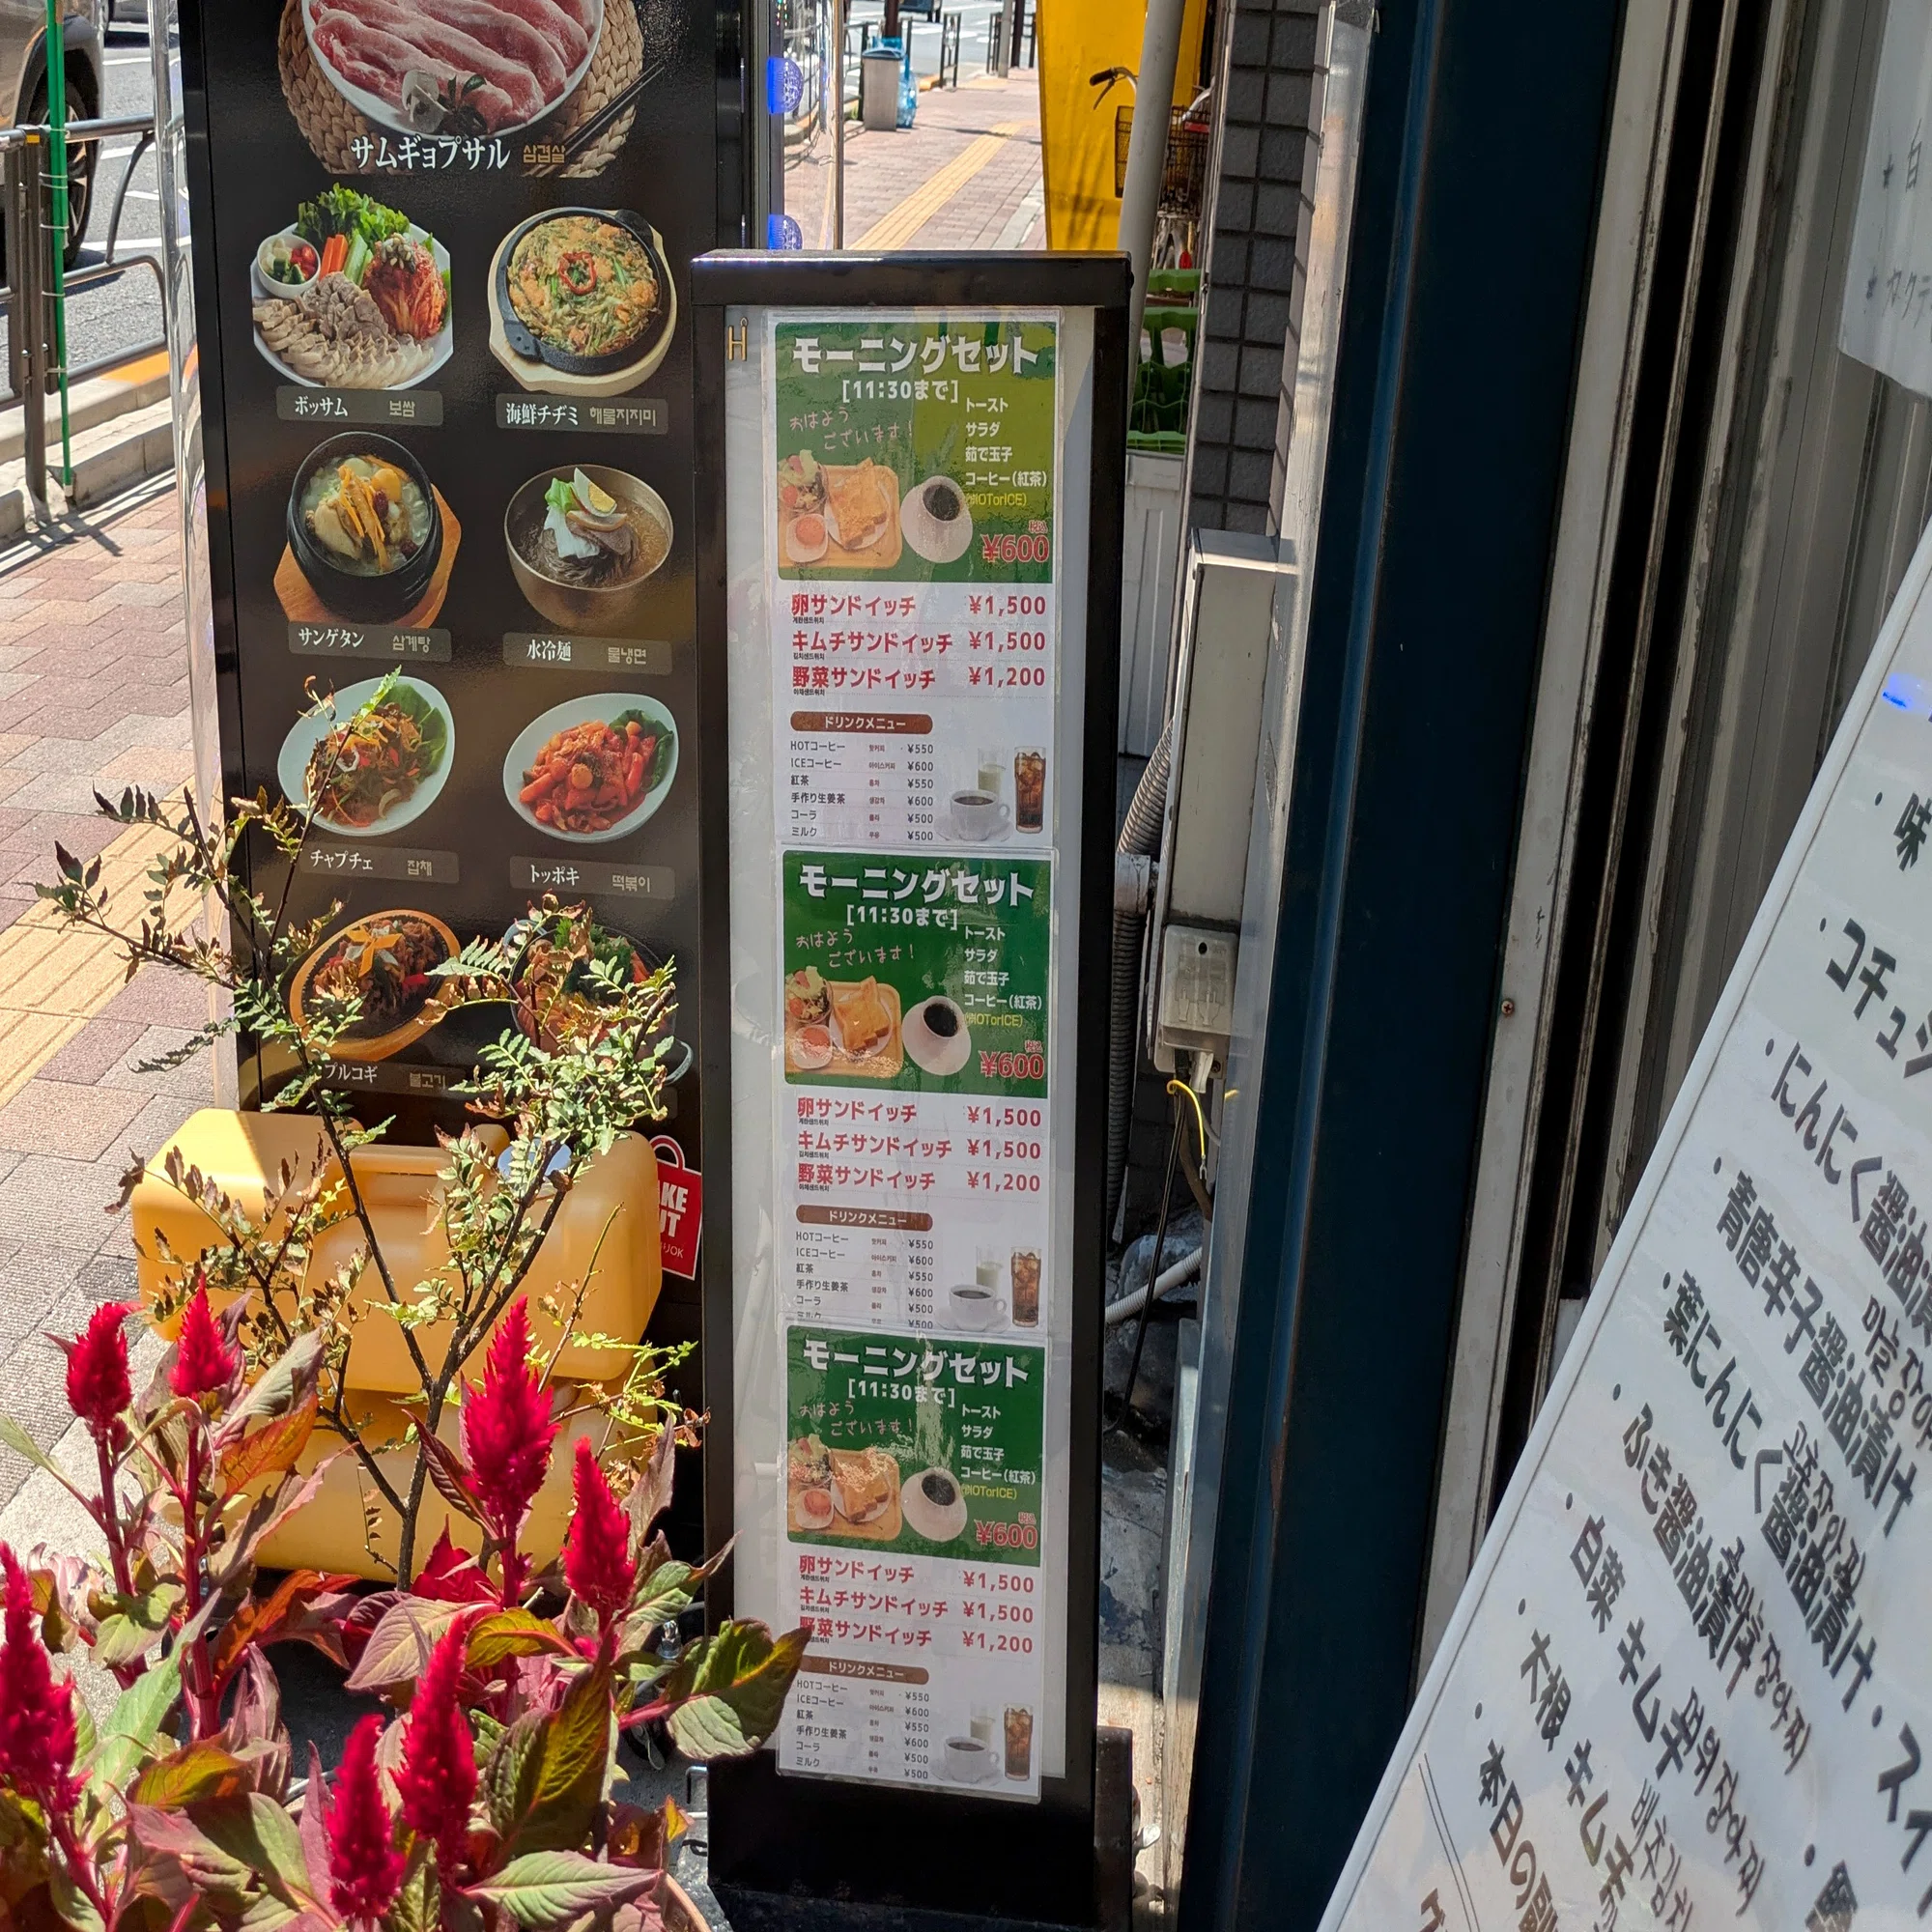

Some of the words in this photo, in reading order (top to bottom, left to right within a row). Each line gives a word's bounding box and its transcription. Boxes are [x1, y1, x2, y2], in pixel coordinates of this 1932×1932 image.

[351, 133, 510, 171] サムギョプサル
[523, 144, 566, 164] 삼겹살
[792, 335, 1039, 374] モーニングセット
[842, 380, 958, 403] [11:30まで]
[295, 396, 349, 417] ボッサム
[389, 400, 415, 417] 보쌈
[506, 402, 579, 426] 海鮮チヂミ
[589, 406, 656, 427] 해물지지미
[966, 397, 1009, 412] トースト
[789, 407, 850, 432] おはよう
[966, 421, 1001, 437] サラダ
[966, 446, 1012, 463] 茹で玉子
[966, 470, 1047, 487] コーヒー(紅茶)
[980, 533, 1050, 563] ¥600
[791, 593, 916, 616] 卵サンドイッチ
[969, 595, 1046, 616] ¥1,500
[298, 628, 364, 649] サンゲタン
[392, 635, 431, 654] 삼계탕
[792, 630, 952, 654] キムチサンドイッチ
[969, 631, 1046, 651] ¥1,500
[608, 646, 647, 666] 물냉면
[792, 666, 936, 690] 野菜サンドイッチ
[969, 667, 1045, 687] ¥1,200
[824, 715, 906, 729] ドリンクメニュー
[790, 741, 845, 752] HOTコーヒー
[907, 743, 934, 754] ¥550
[791, 757, 842, 769] ICEコーヒー
[907, 761, 934, 772] ¥600
[790, 775, 810, 786] 紅茶
[907, 779, 934, 790] ¥550
[907, 796, 934, 807] ¥600
[791, 810, 817, 820] コーラ
[907, 813, 934, 824] ¥500
[791, 826, 817, 838] ミルク
[907, 831, 934, 842] ¥500
[310, 848, 374, 871] チャプチェ
[407, 859, 433, 876] 잡채
[530, 864, 580, 886] トッポキ
[612, 873, 651, 893] 떡볶이
[799, 864, 1034, 907] モーニングセット
[846, 904, 957, 931] [11:30まで]
[796, 928, 854, 949] おはよう
[965, 926, 1006, 941] トースト
[964, 949, 998, 963] サラダ
[964, 971, 1009, 986] 茹で玉子
[979, 1050, 1044, 1080] ¥600
[410, 1072, 446, 1090] 불고기
[797, 1097, 917, 1122] 卵サンドイッチ
[967, 1105, 1041, 1127] ¥1,500
[798, 1131, 952, 1158] キムチサンドイッチ
[967, 1139, 1040, 1160] ¥1,500
[798, 1163, 935, 1191] 野菜サンドイッチ
[967, 1171, 1040, 1192] ¥1,200
[658, 1179, 689, 1213] KE
[659, 1208, 681, 1237] UT
[829, 1209, 907, 1225] ドリンクメニュー
[908, 1238, 933, 1250] ¥550
[908, 1255, 933, 1266] ¥600
[908, 1271, 933, 1282] ¥550
[908, 1288, 933, 1298] ¥600
[908, 1303, 933, 1314] ¥500
[908, 1319, 933, 1329] ¥500
[803, 1338, 1029, 1388] モーニングセット
[961, 1404, 1001, 1420] トースト
[961, 1424, 993, 1439] サラダ
[974, 1520, 1037, 1549] ¥600
[799, 1555, 914, 1583] 卵サンドイッチ
[963, 1571, 1034, 1593] ¥1,500
[800, 1586, 948, 1617] キムチサンドイッチ
[963, 1601, 1034, 1624] ¥1,500
[962, 1632, 1033, 1654] ¥1,200
[1570, 1514, 1626, 1633] 白菜
[1617, 1616, 1688, 1779] キムチ
[1520, 1628, 1571, 1751] 大根
[1564, 1738, 1634, 1906] キムチ
